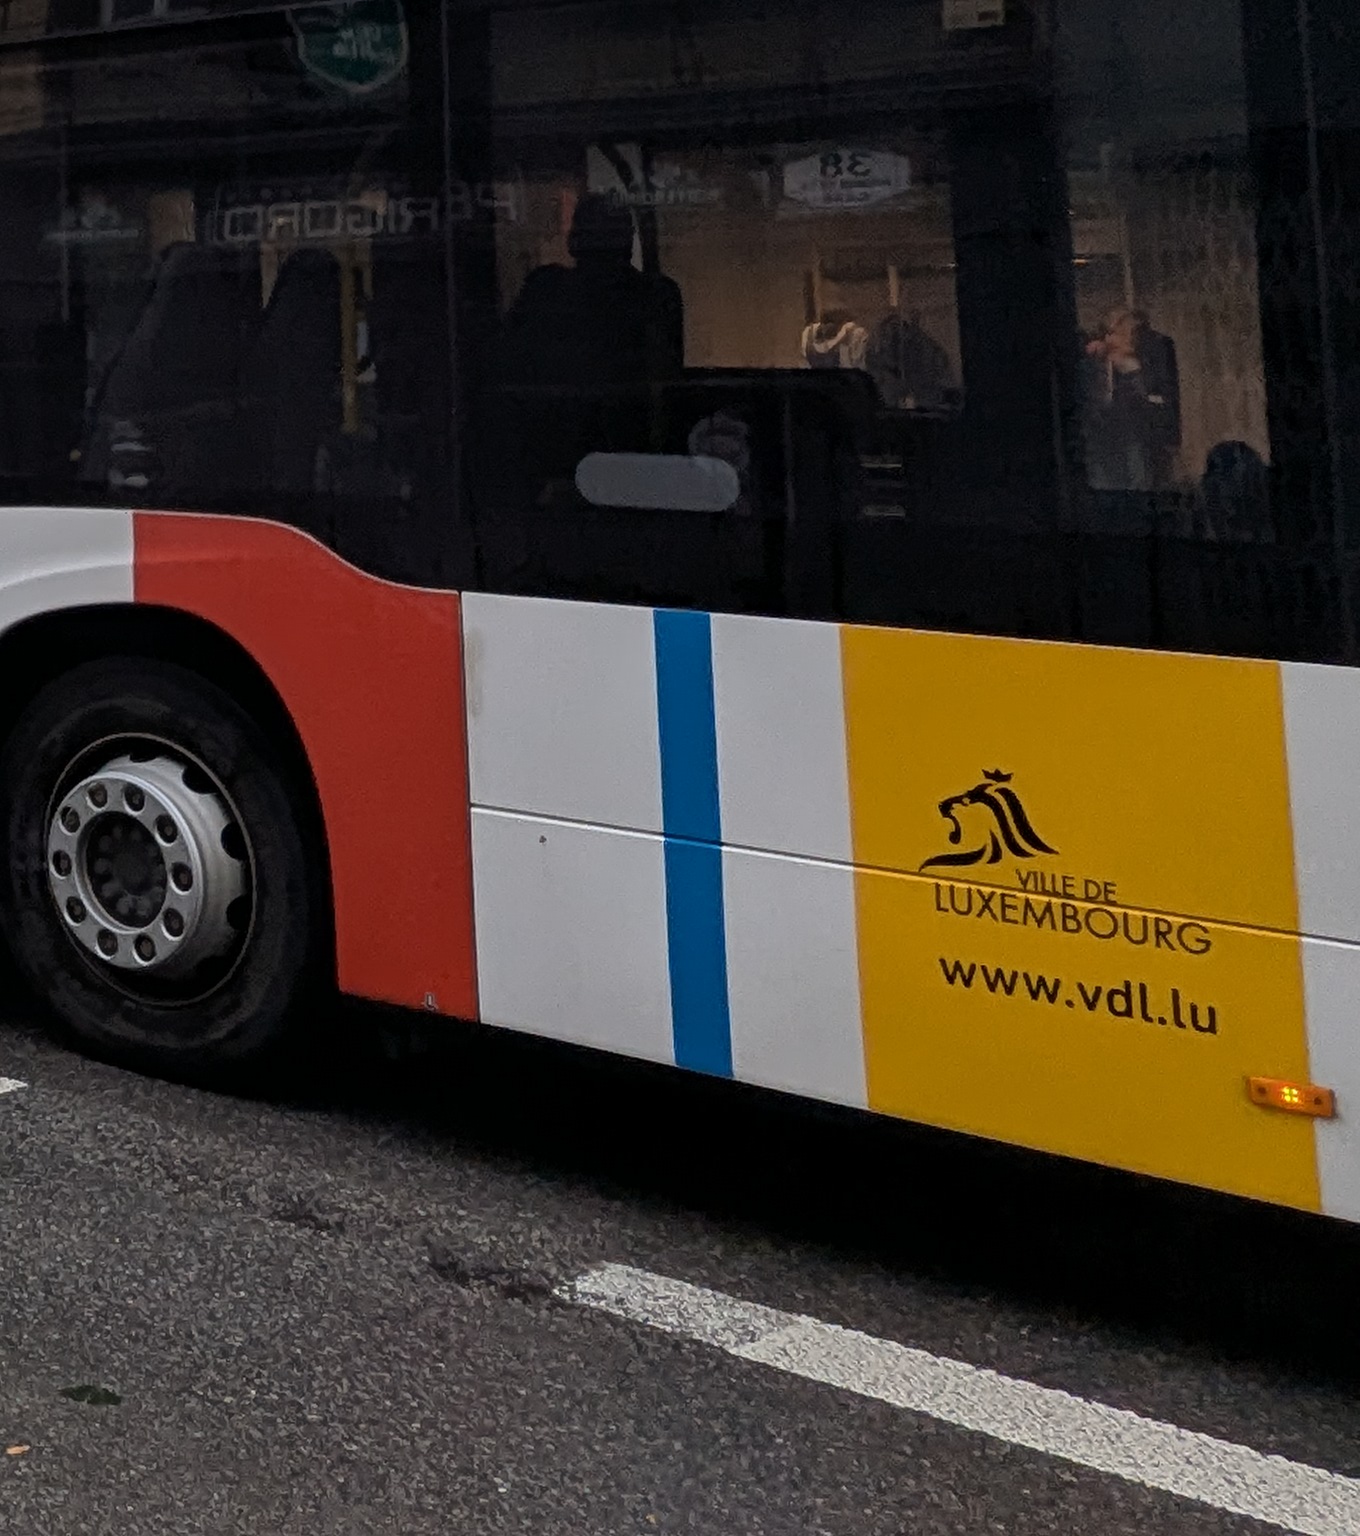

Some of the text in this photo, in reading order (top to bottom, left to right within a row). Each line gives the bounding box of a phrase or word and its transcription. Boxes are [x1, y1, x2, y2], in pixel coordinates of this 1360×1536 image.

[934, 882, 1212, 955] LUXEMBOURG
[1015, 868, 1118, 904] VILLE DE
[938, 957, 1219, 1035] www.vdl.lu
